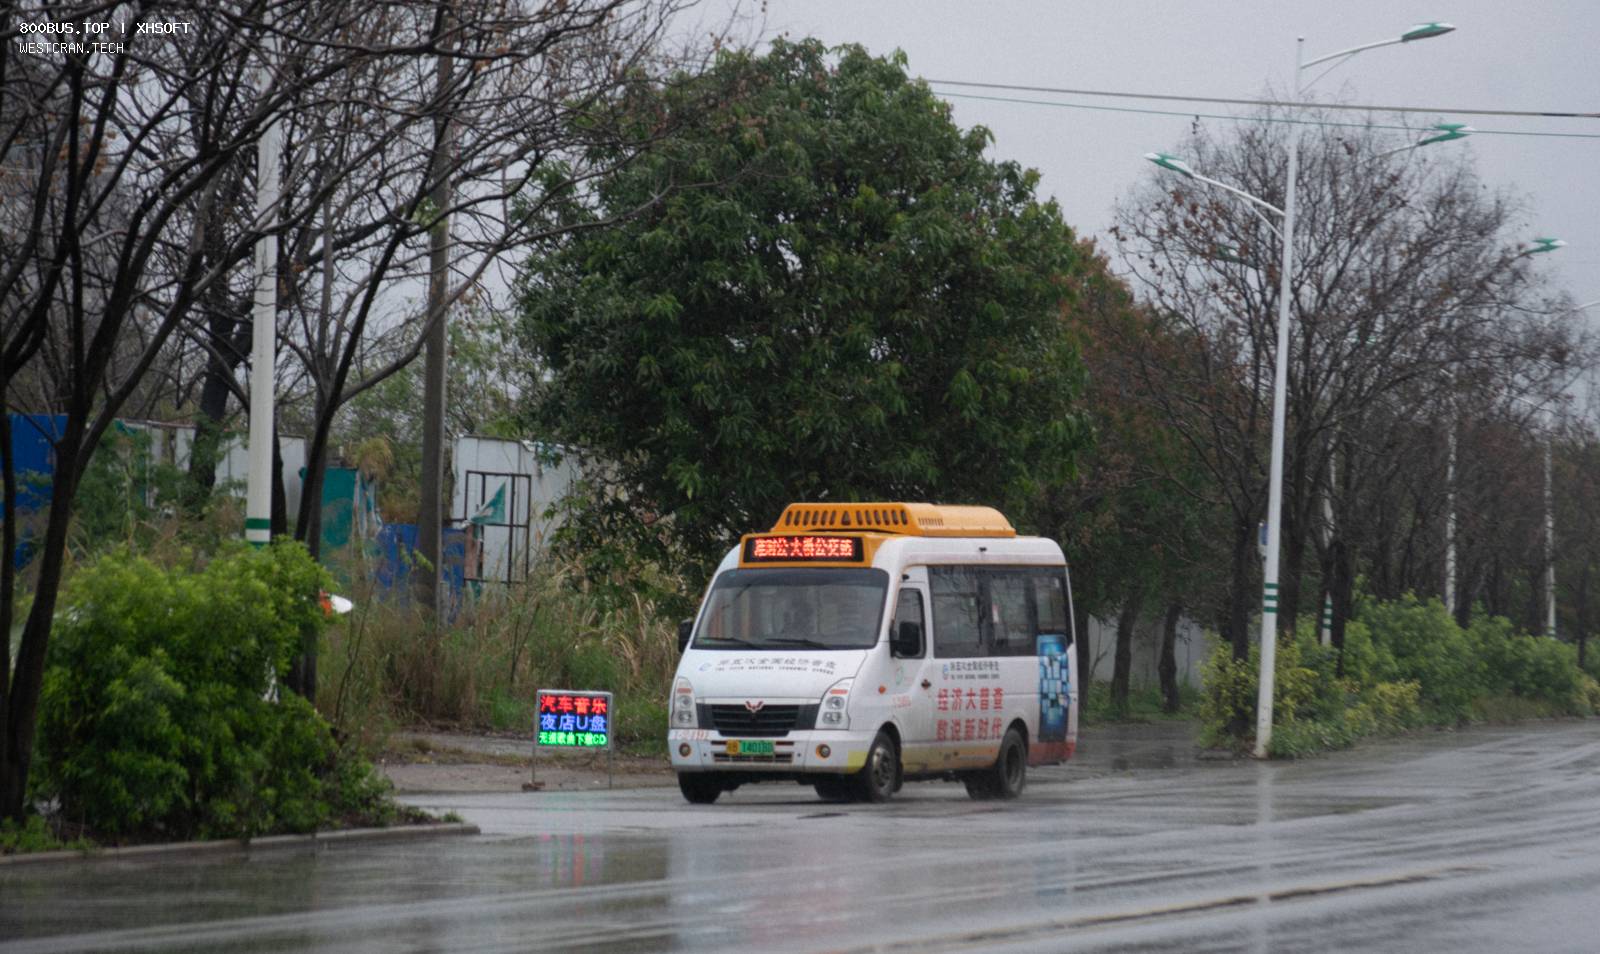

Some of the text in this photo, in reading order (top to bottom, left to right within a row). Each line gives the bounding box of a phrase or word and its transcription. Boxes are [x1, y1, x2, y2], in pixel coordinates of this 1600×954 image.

[541, 695, 607, 714] 汽车音乐
[937, 687, 1004, 711] 经济大普查
[540, 713, 607, 732] 夜店U盘
